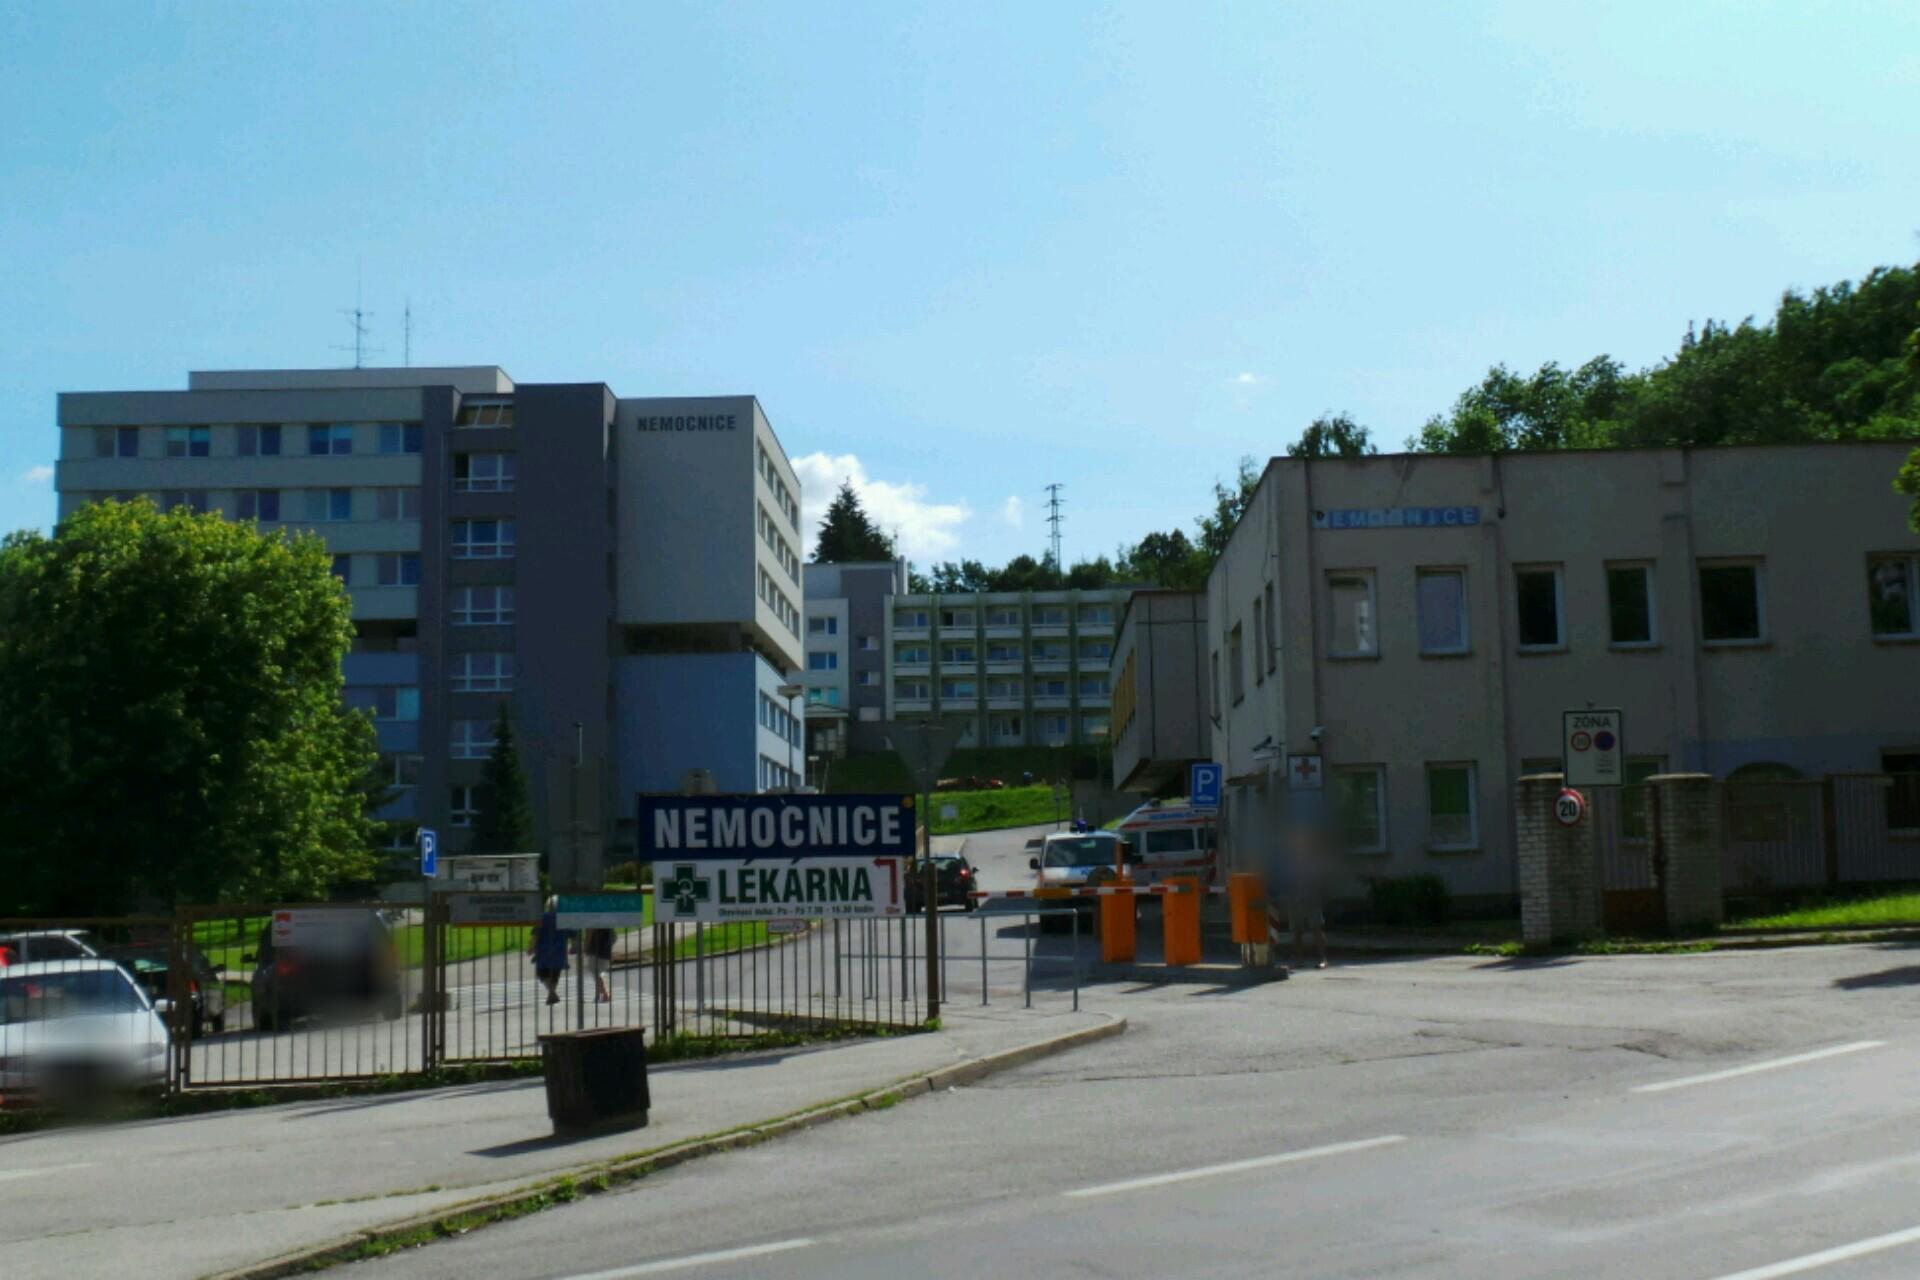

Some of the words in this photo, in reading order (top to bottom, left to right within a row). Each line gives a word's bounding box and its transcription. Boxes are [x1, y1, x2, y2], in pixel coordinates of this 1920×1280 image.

[638, 414, 736, 432] NEMOCNICE
[1197, 769, 1214, 792] P
[1560, 800, 1576, 816] 20
[654, 805, 901, 848] NEMOCNICE
[424, 832, 433, 862] P
[718, 857, 873, 904] LÉKÁRNA
